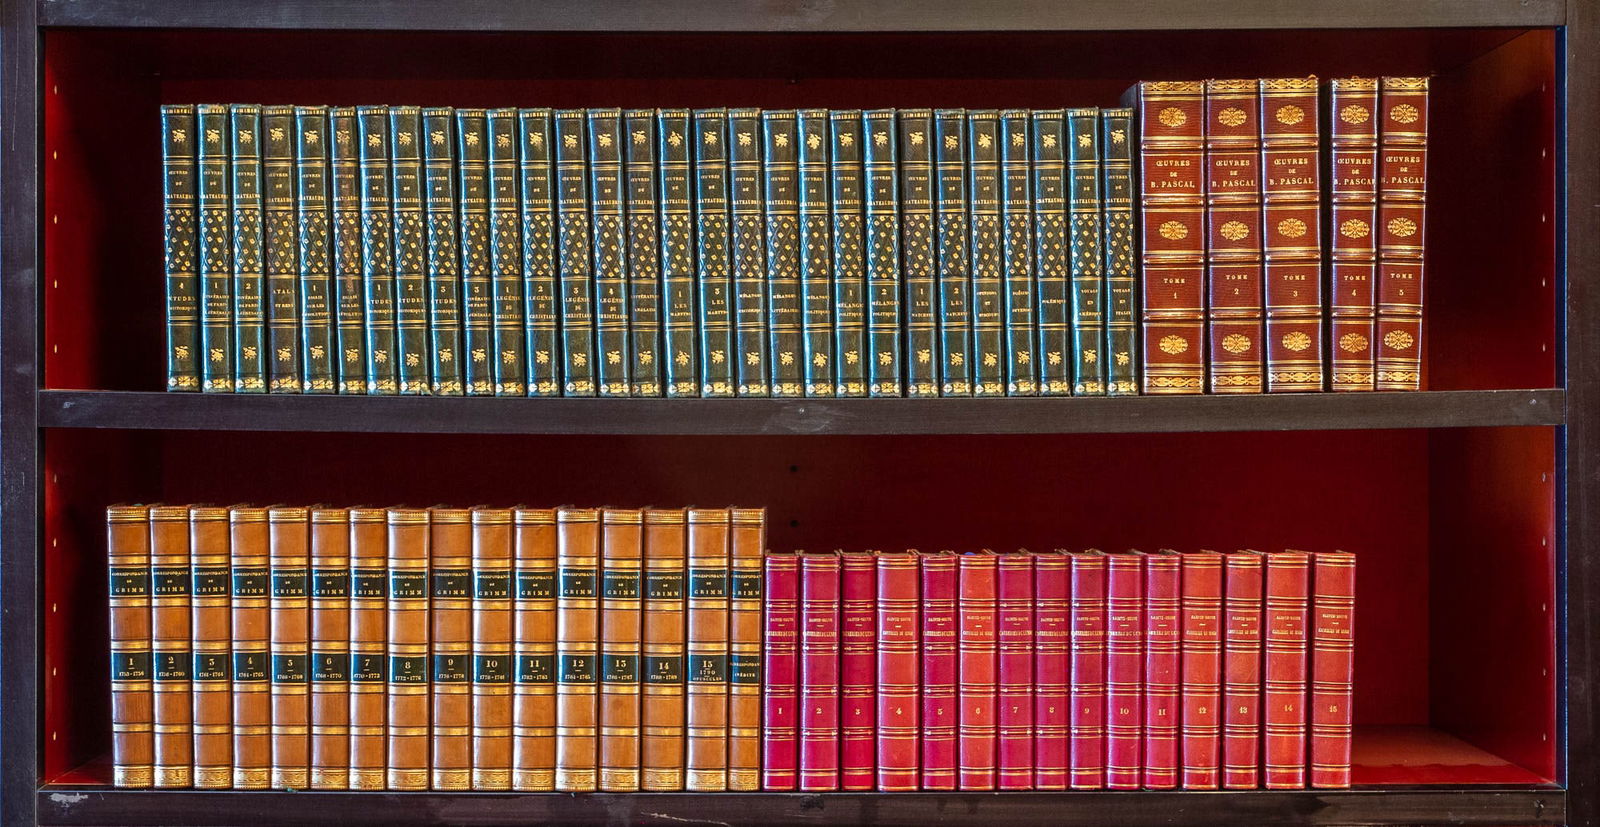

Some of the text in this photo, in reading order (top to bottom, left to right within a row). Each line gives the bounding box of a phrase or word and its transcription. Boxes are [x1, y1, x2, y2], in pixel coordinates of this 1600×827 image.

[1222, 179, 1256, 187] PASCAL
[1280, 177, 1314, 185] PASCAL
[1391, 176, 1425, 184] PASCAL
[1351, 289, 1357, 297] 4
[168, 656, 174, 664] 2
[208, 658, 215, 666] 3
[572, 659, 584, 667] 12
[703, 660, 713, 668] 15
[404, 661, 411, 669] 8
[659, 662, 669, 670] 14
[1158, 708, 1166, 716] 11
[1329, 705, 1338, 713] 15
